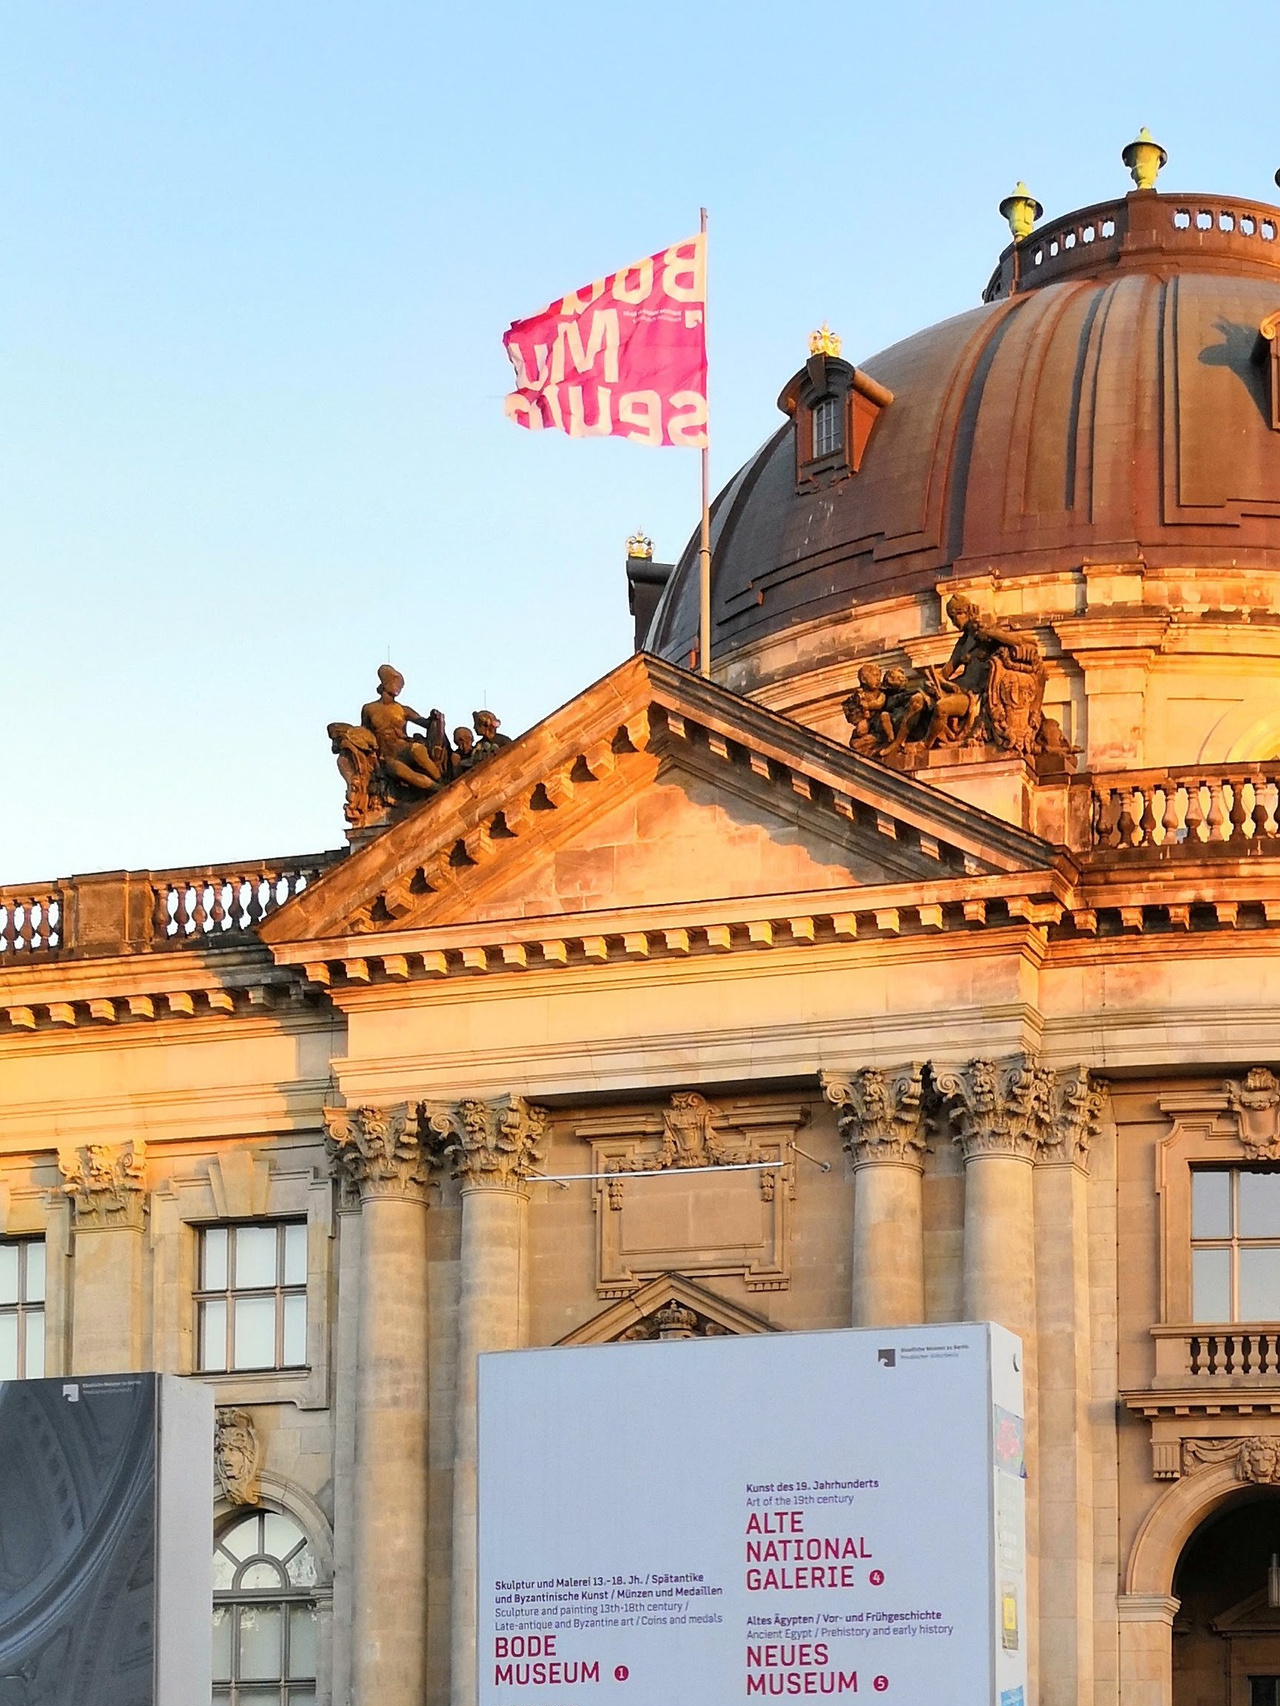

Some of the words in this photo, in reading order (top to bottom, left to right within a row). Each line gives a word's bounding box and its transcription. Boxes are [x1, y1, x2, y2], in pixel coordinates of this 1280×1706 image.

[747, 1483, 774, 1492] Kunst
[777, 1482, 794, 1492] des
[796, 1482, 811, 1491] 19.
[813, 1479, 879, 1490] Jahrhunderts
[747, 1497, 761, 1507] Art
[764, 1496, 773, 1506] of
[775, 1496, 791, 1505] the
[794, 1495, 814, 1505] 19th
[817, 1494, 854, 1505] century
[746, 1511, 804, 1534] ALTE
[747, 1537, 872, 1562] NATIONAL
[495, 1580, 534, 1591] Skulptur
[537, 1578, 554, 1588] und
[556, 1577, 590, 1587] Malerei
[628, 1576, 643, 1585] Jh.
[652, 1573, 703, 1584] Spätantike
[747, 1566, 854, 1590] GALERIE
[495, 1594, 512, 1604] und
[514, 1592, 579, 1604] Byzantinische
[582, 1591, 608, 1601] Kunst
[617, 1589, 653, 1599] Münzen
[656, 1587, 672, 1597] und
[675, 1586, 723, 1597] Medaillen
[495, 1606, 539, 1619] Sculpture
[541, 1605, 558, 1616] and
[560, 1604, 598, 1617] painting
[601, 1602, 645, 1614] 13th-18th
[647, 1602, 682, 1613] century
[747, 1616, 772, 1625] Altes
[774, 1613, 814, 1627] Ägypten
[823, 1614, 843, 1623] Vor-
[846, 1613, 863, 1622] und
[866, 1611, 941, 1623] Frühgeschichte
[495, 1620, 552, 1631] Late-antique
[555, 1619, 571, 1628] and
[574, 1618, 618, 1630] Byzantine
[621, 1617, 634, 1626] art
[642, 1615, 667, 1625] Coins
[670, 1614, 686, 1624] and
[689, 1613, 722, 1623] medals
[747, 1629, 782, 1639] Ancient
[785, 1629, 812, 1640] Egypt
[822, 1627, 870, 1638] Prehistory
[873, 1626, 890, 1636] and
[893, 1625, 917, 1637] early
[920, 1624, 953, 1636] history
[495, 1635, 556, 1658] BODE
[747, 1644, 828, 1667] NEUES
[495, 1662, 599, 1685] MUSEUM
[747, 1671, 858, 1695] MUSEUM
